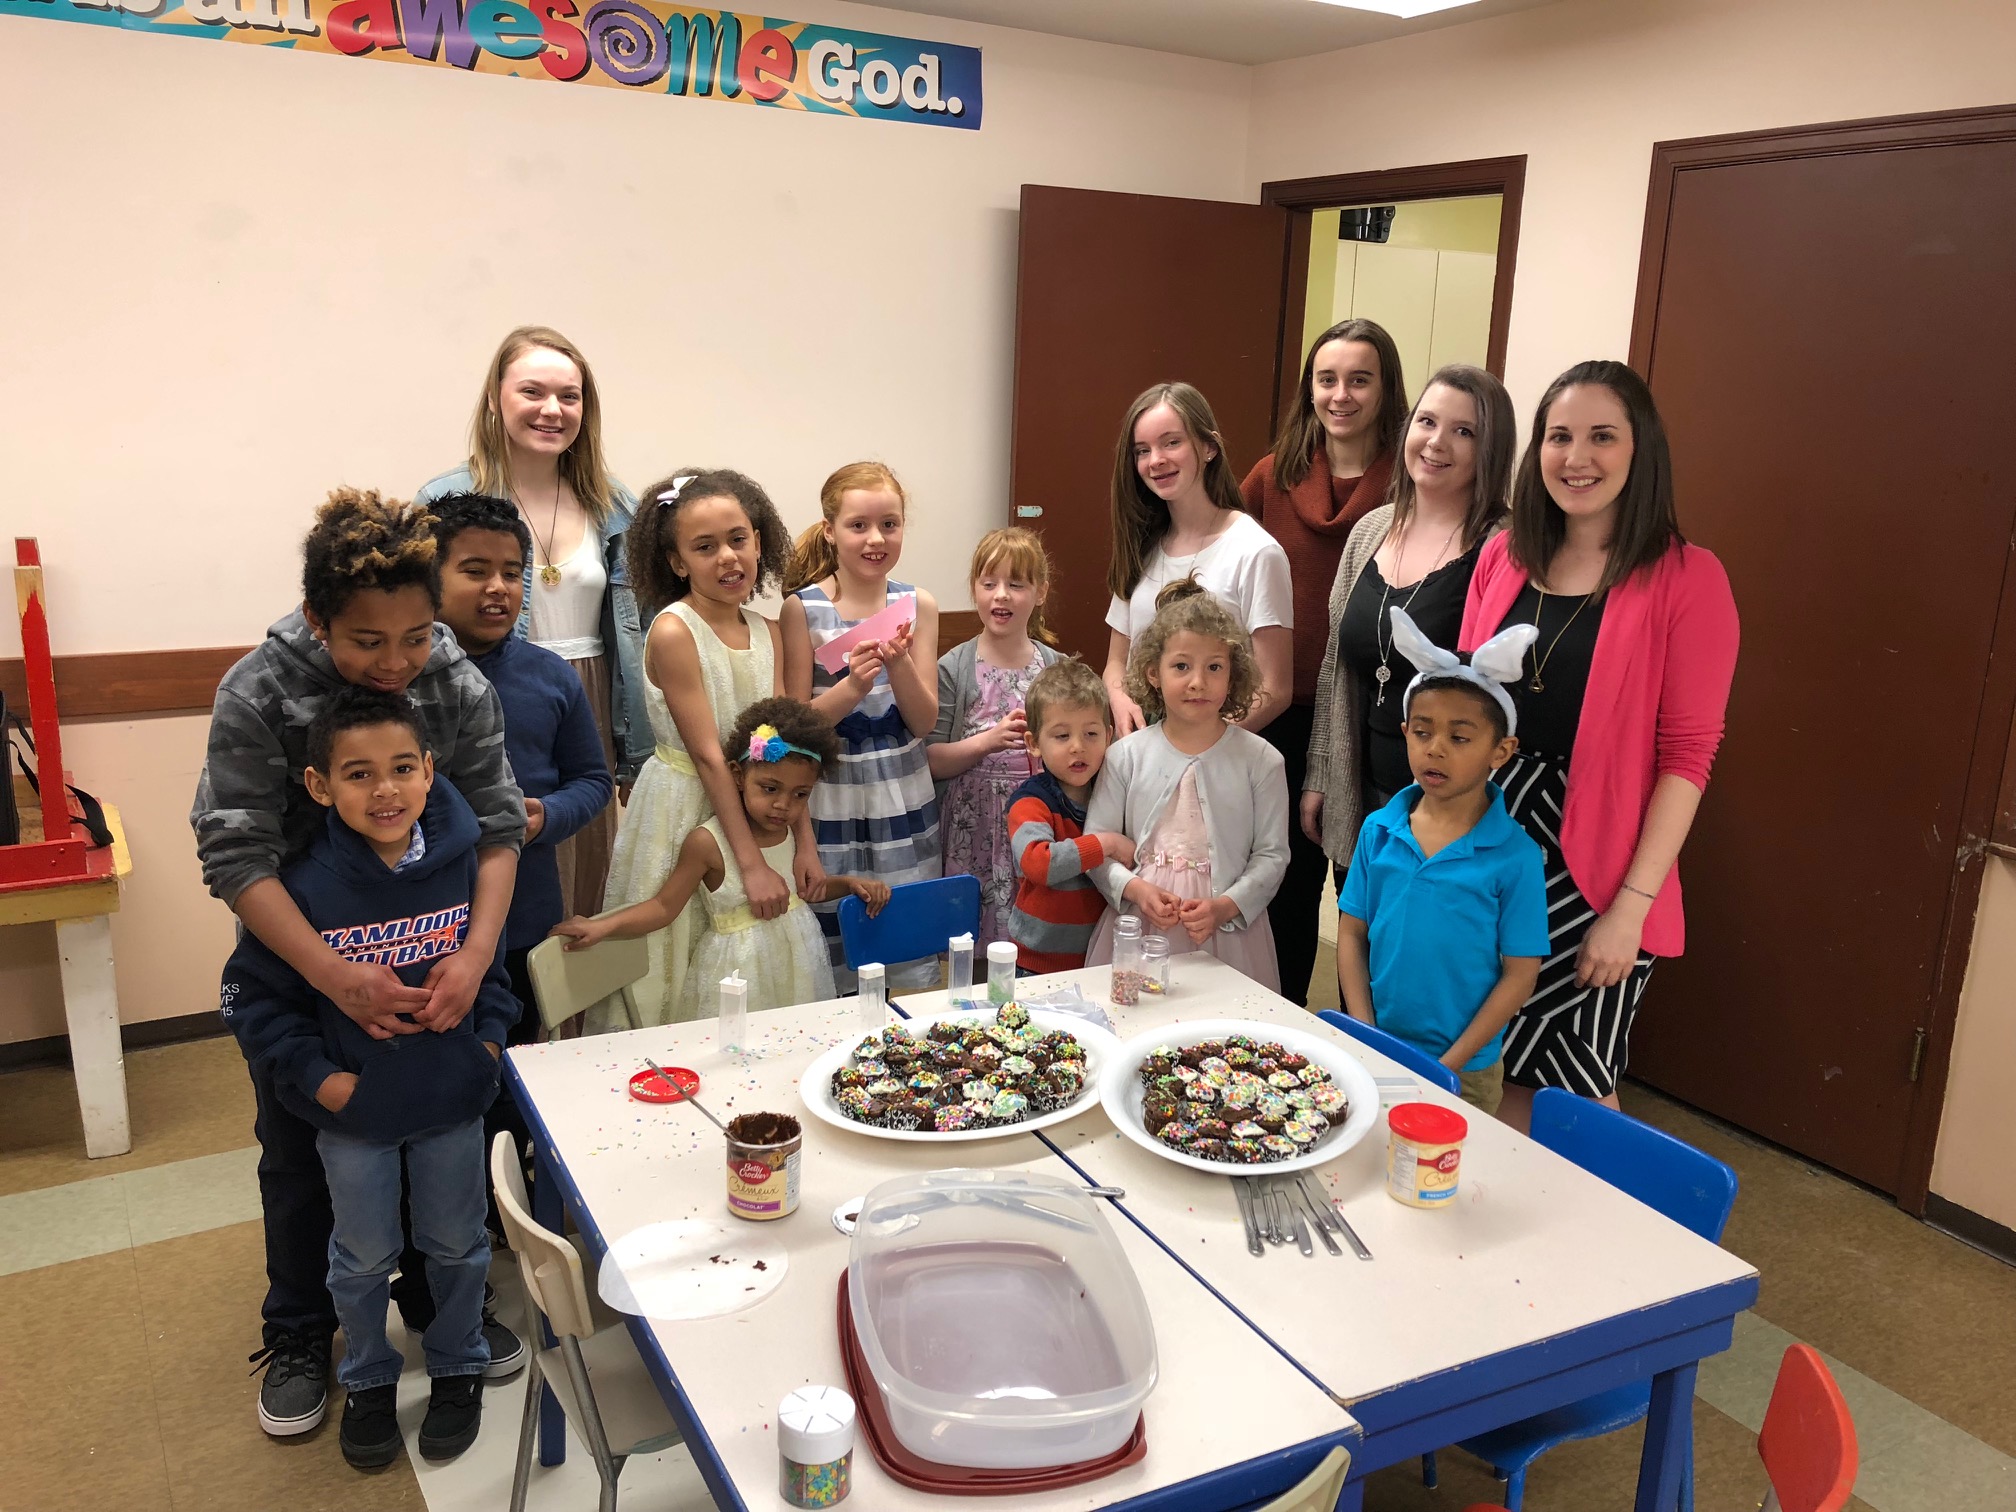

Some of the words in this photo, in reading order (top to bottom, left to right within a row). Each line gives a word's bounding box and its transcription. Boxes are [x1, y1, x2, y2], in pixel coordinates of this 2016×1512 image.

[327, 0, 795, 101] awesome
[808, 39, 964, 115] God.
[744, 1162, 764, 1173] Betty
[739, 1168, 766, 1180] Crocker
[736, 1200, 764, 1210] CHOCOLAT
